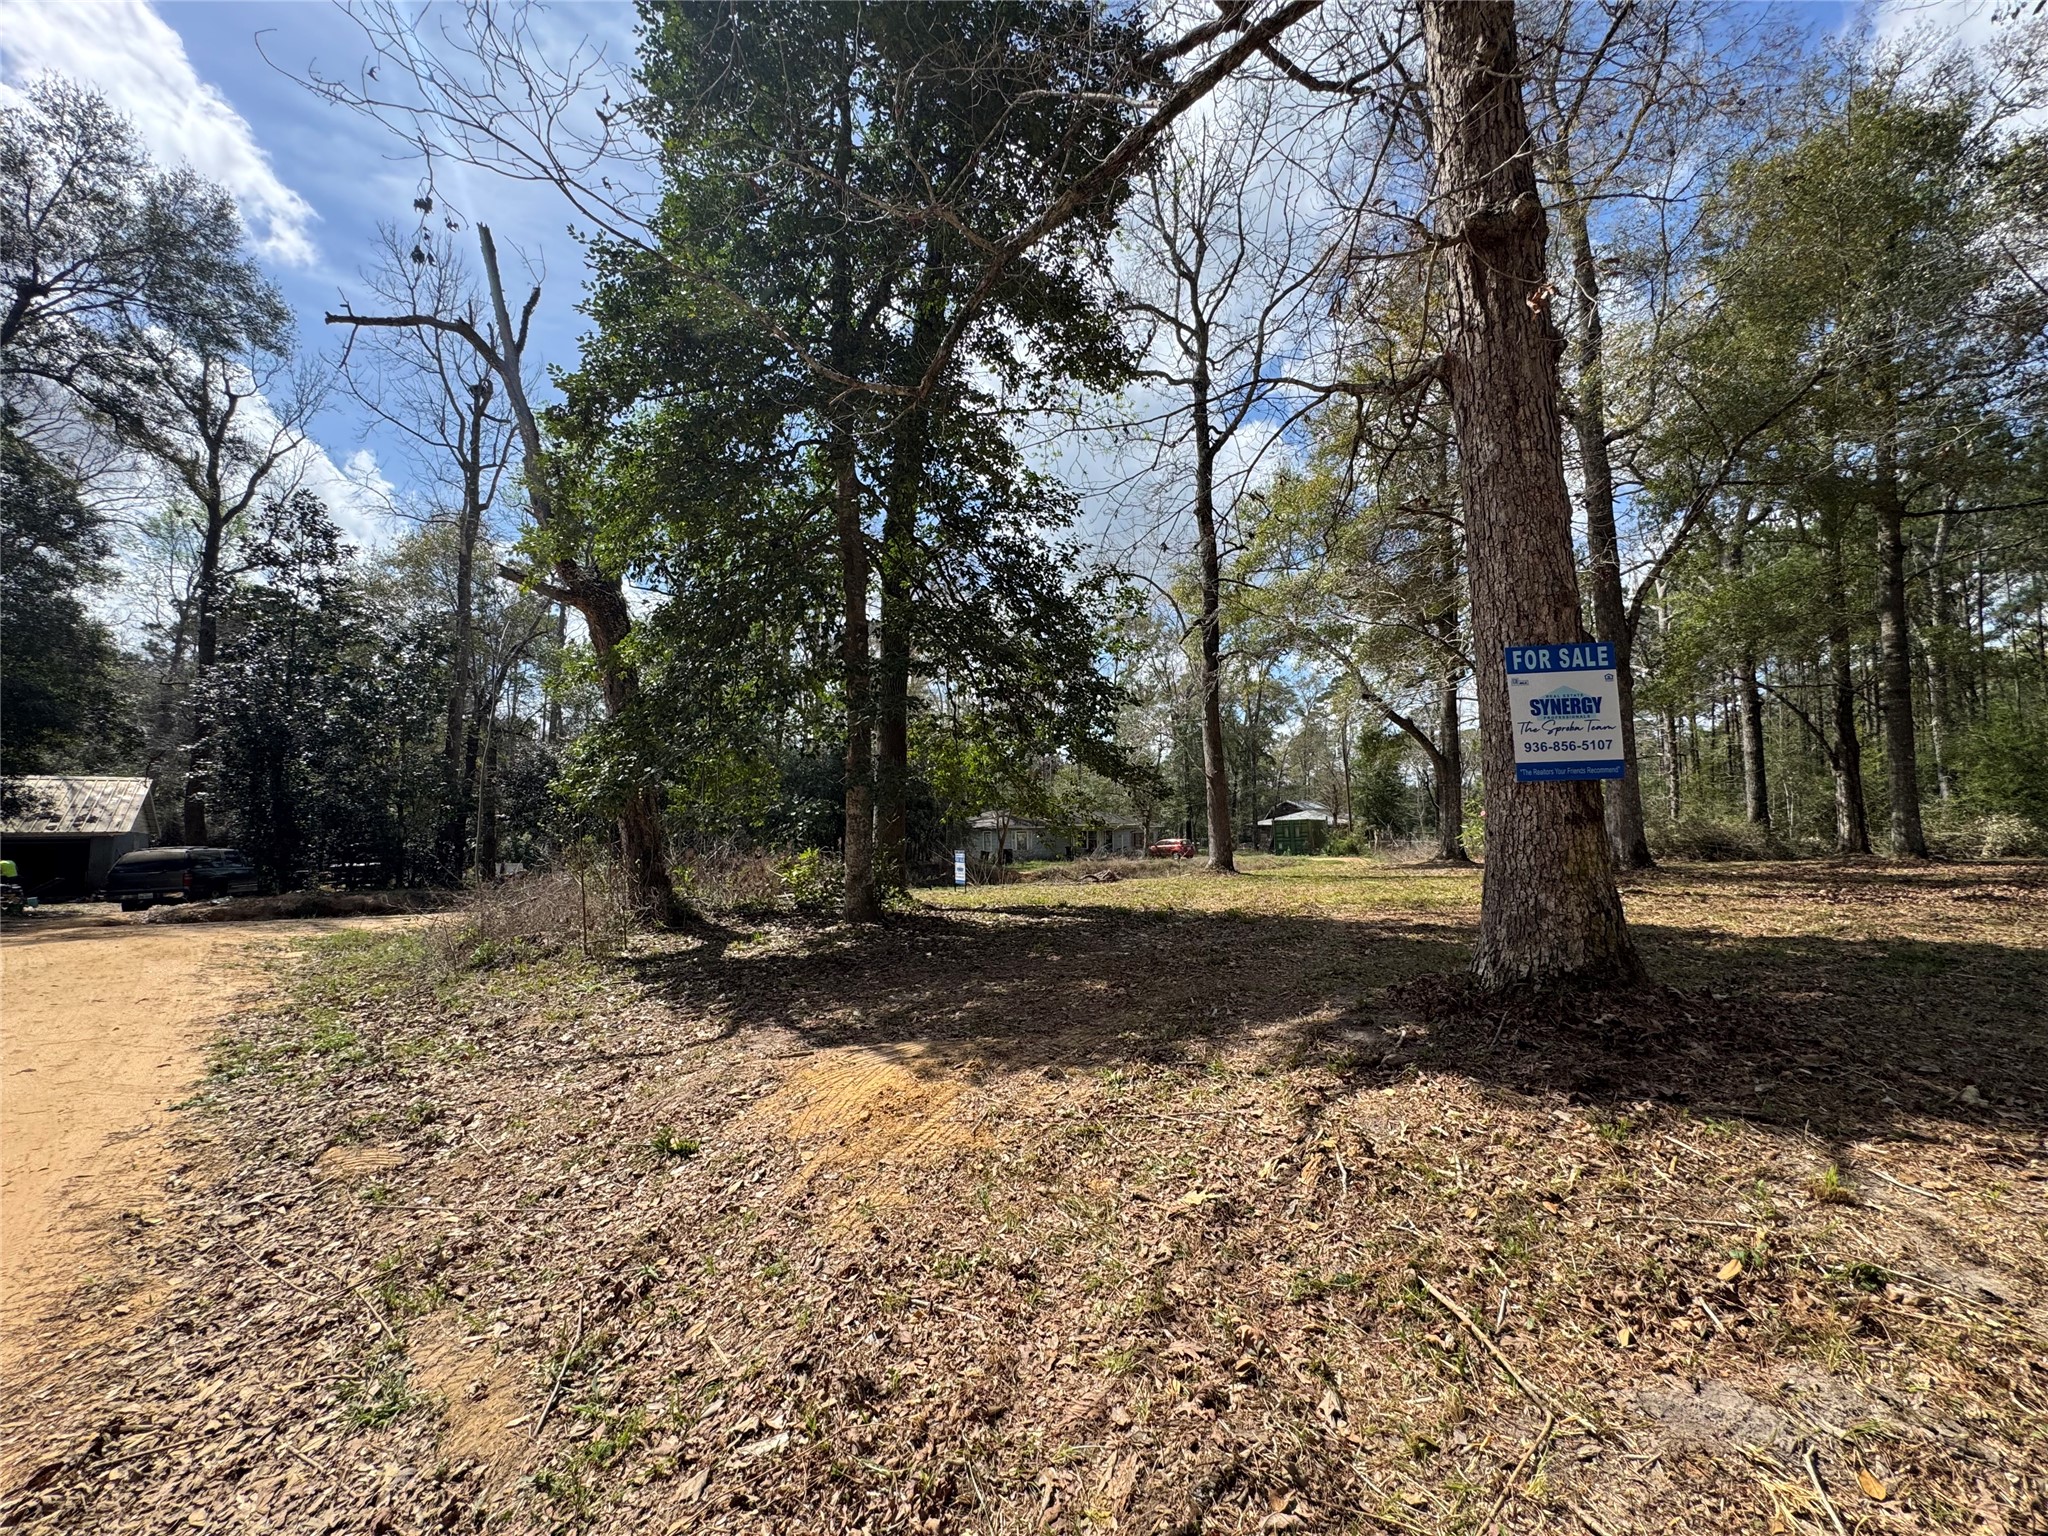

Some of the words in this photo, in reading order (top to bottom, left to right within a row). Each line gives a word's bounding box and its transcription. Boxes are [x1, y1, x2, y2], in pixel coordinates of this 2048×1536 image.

[1512, 649, 1551, 670] FOR
[1559, 646, 1609, 668] SALE
[1529, 697, 1602, 716] SYNERGY
[1517, 721, 1541, 735] The
[1584, 719, 1616, 732] Team
[1524, 740, 1613, 752] 936-856-5107
